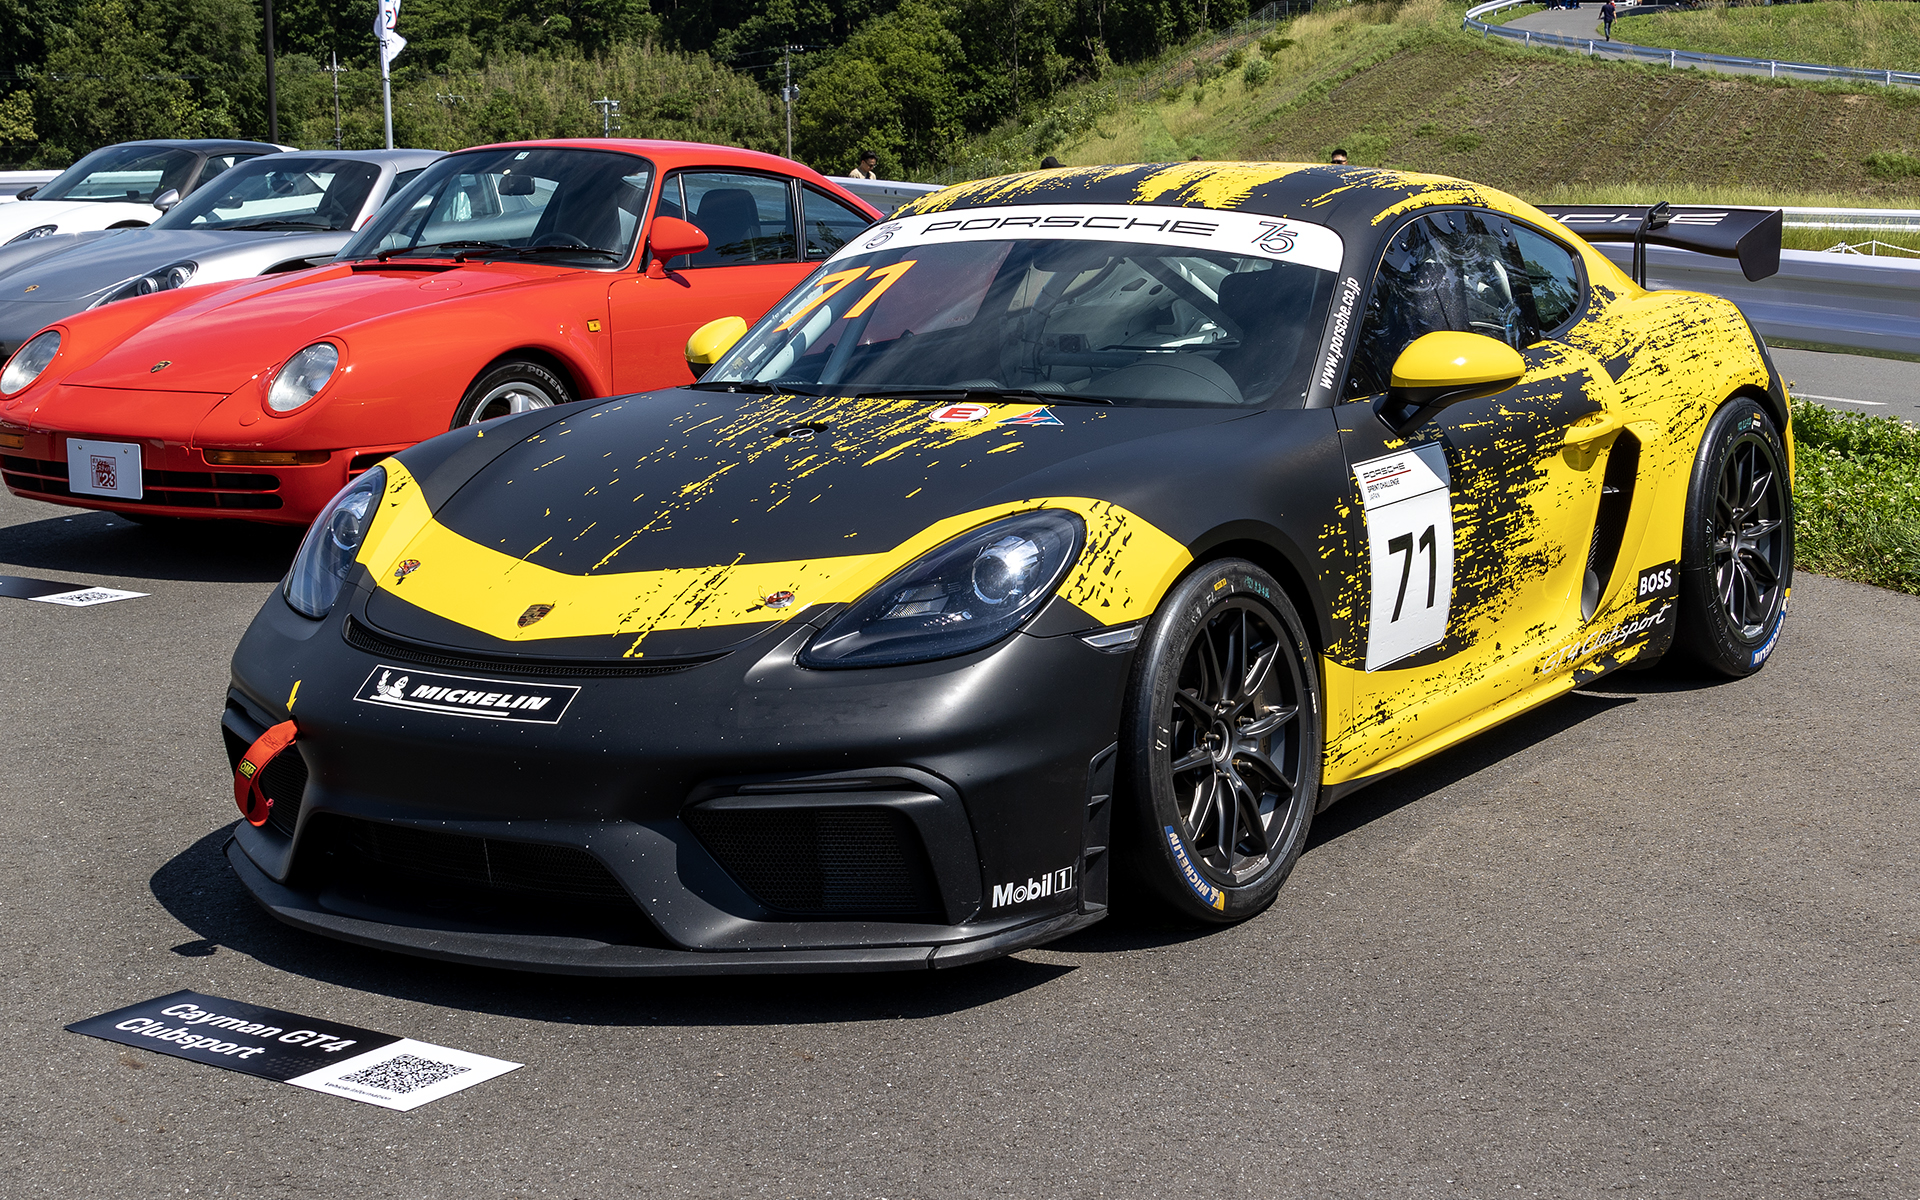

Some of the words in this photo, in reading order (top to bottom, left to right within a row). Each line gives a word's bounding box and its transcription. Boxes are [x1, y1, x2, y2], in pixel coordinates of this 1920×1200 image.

[920, 216, 1219, 236] PORSCHE
[1251, 221, 1298, 254] 75
[772, 260, 918, 333] 71
[1320, 276, 1361, 390] www.porsche.co.jp
[527, 365, 569, 403] POTENZ
[939, 407, 980, 419] E
[1363, 462, 1405, 478] PORSCHE
[1388, 524, 1437, 624] 71
[1639, 568, 1672, 596] BOSS
[1542, 641, 1580, 675] GT4
[1581, 604, 1672, 655] Clubsport
[410, 684, 552, 711] MICHELIN
[1169, 832, 1210, 897] MICHELIN
[992, 872, 1053, 908] Mobil
[115, 1017, 265, 1060] Clubsport
[160, 1003, 283, 1038] Cayman
[278, 1029, 357, 1053] GT4
